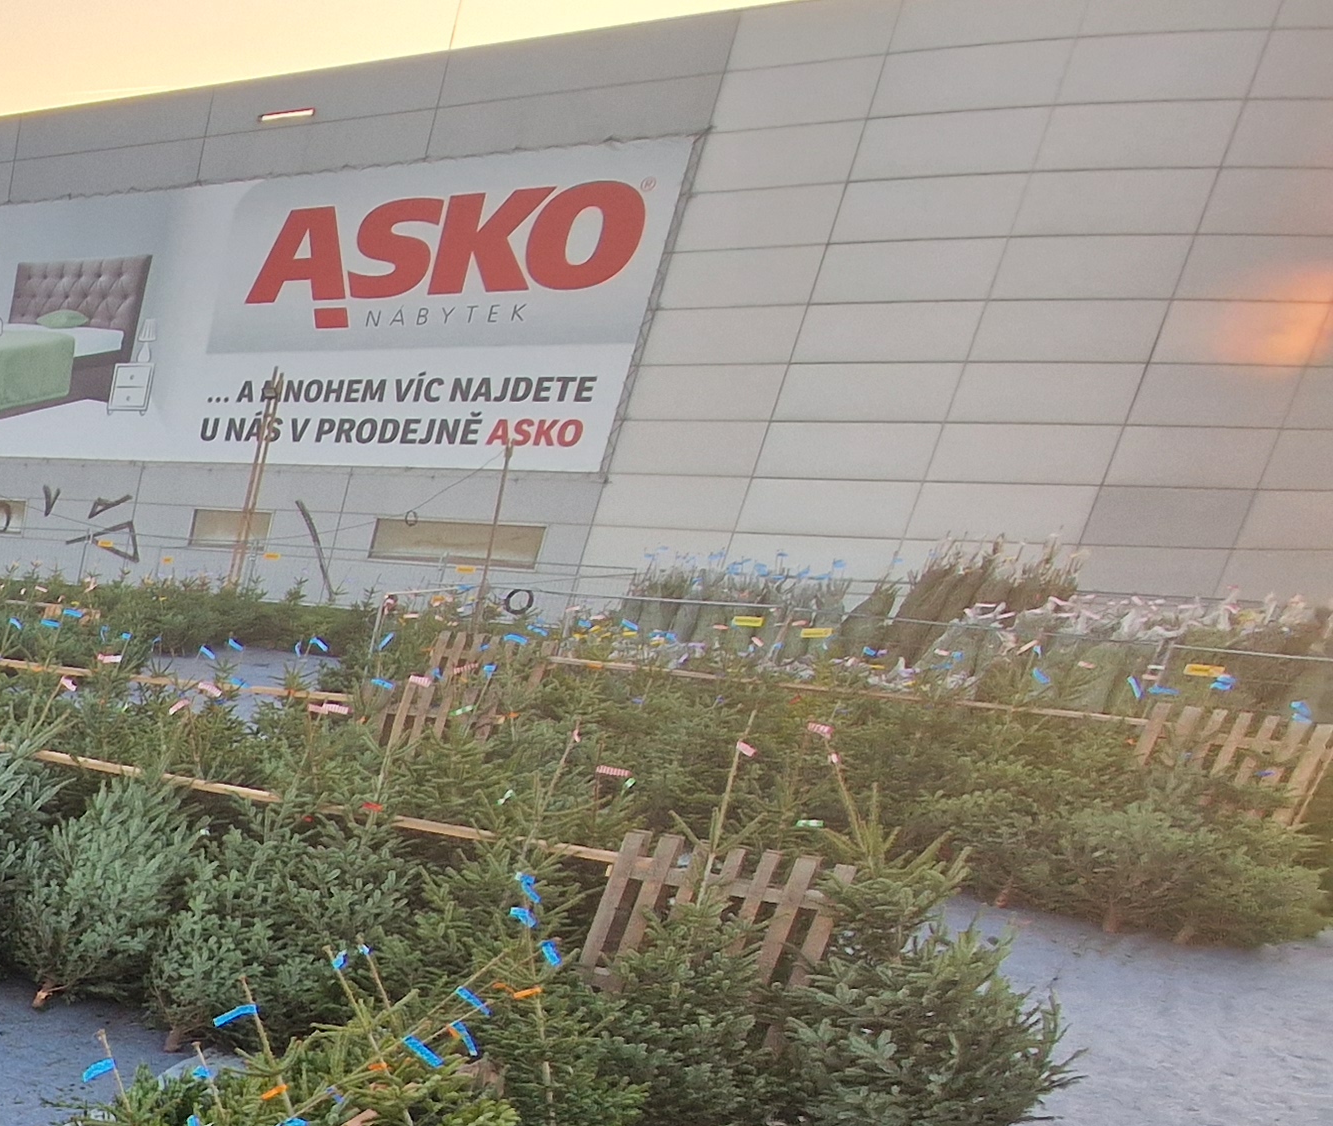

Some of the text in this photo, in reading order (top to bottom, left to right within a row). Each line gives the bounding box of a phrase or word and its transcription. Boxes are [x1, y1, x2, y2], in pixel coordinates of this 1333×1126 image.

[245, 180, 646, 329] ASKO
[365, 303, 527, 328] NÁBYTEK
[236, 380, 253, 402] A
[394, 371, 444, 403] VÍC
[448, 376, 598, 403] NAJDETE
[200, 410, 584, 447] U NÁS V PRODEJNĚ ASKO
